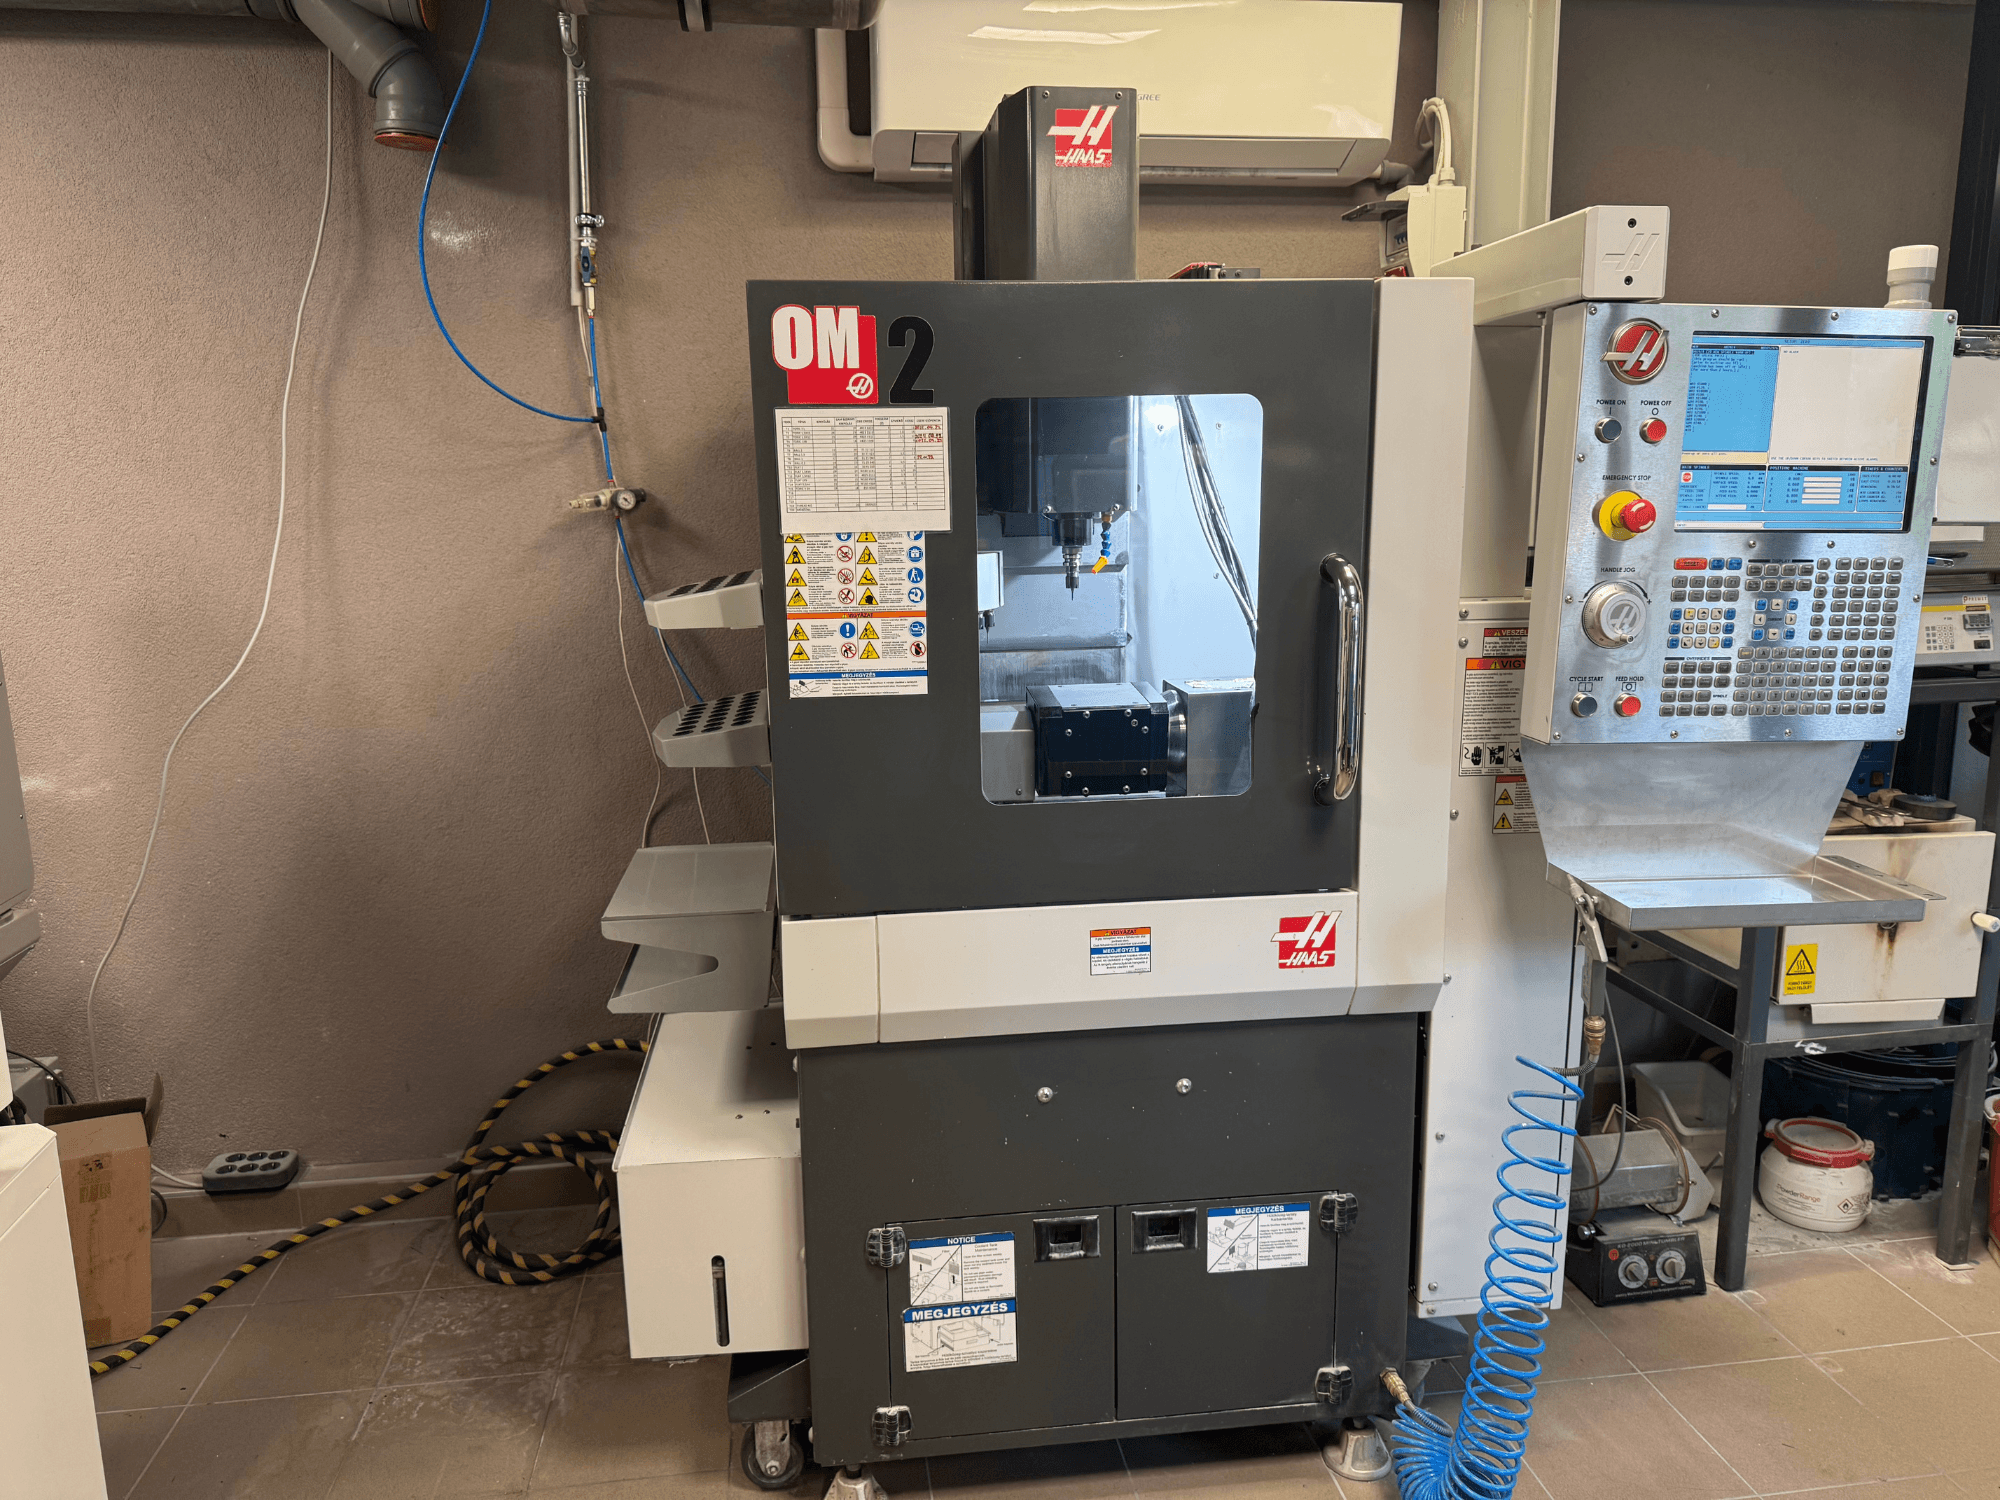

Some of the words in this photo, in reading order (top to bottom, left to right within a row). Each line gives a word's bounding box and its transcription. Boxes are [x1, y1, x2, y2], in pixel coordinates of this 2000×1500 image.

[1055, 148, 1112, 163] HAAS
[771, 304, 860, 371] OM
[887, 315, 936, 404] 2
[1279, 950, 1335, 966] HAAS
[1776, 1183, 1821, 1203] PowderRange
[1235, 1204, 1285, 1215] MEGJEGYZÉS
[947, 1236, 976, 1245] NOTICE
[910, 1301, 1008, 1321] MEGJEGYZÉS
